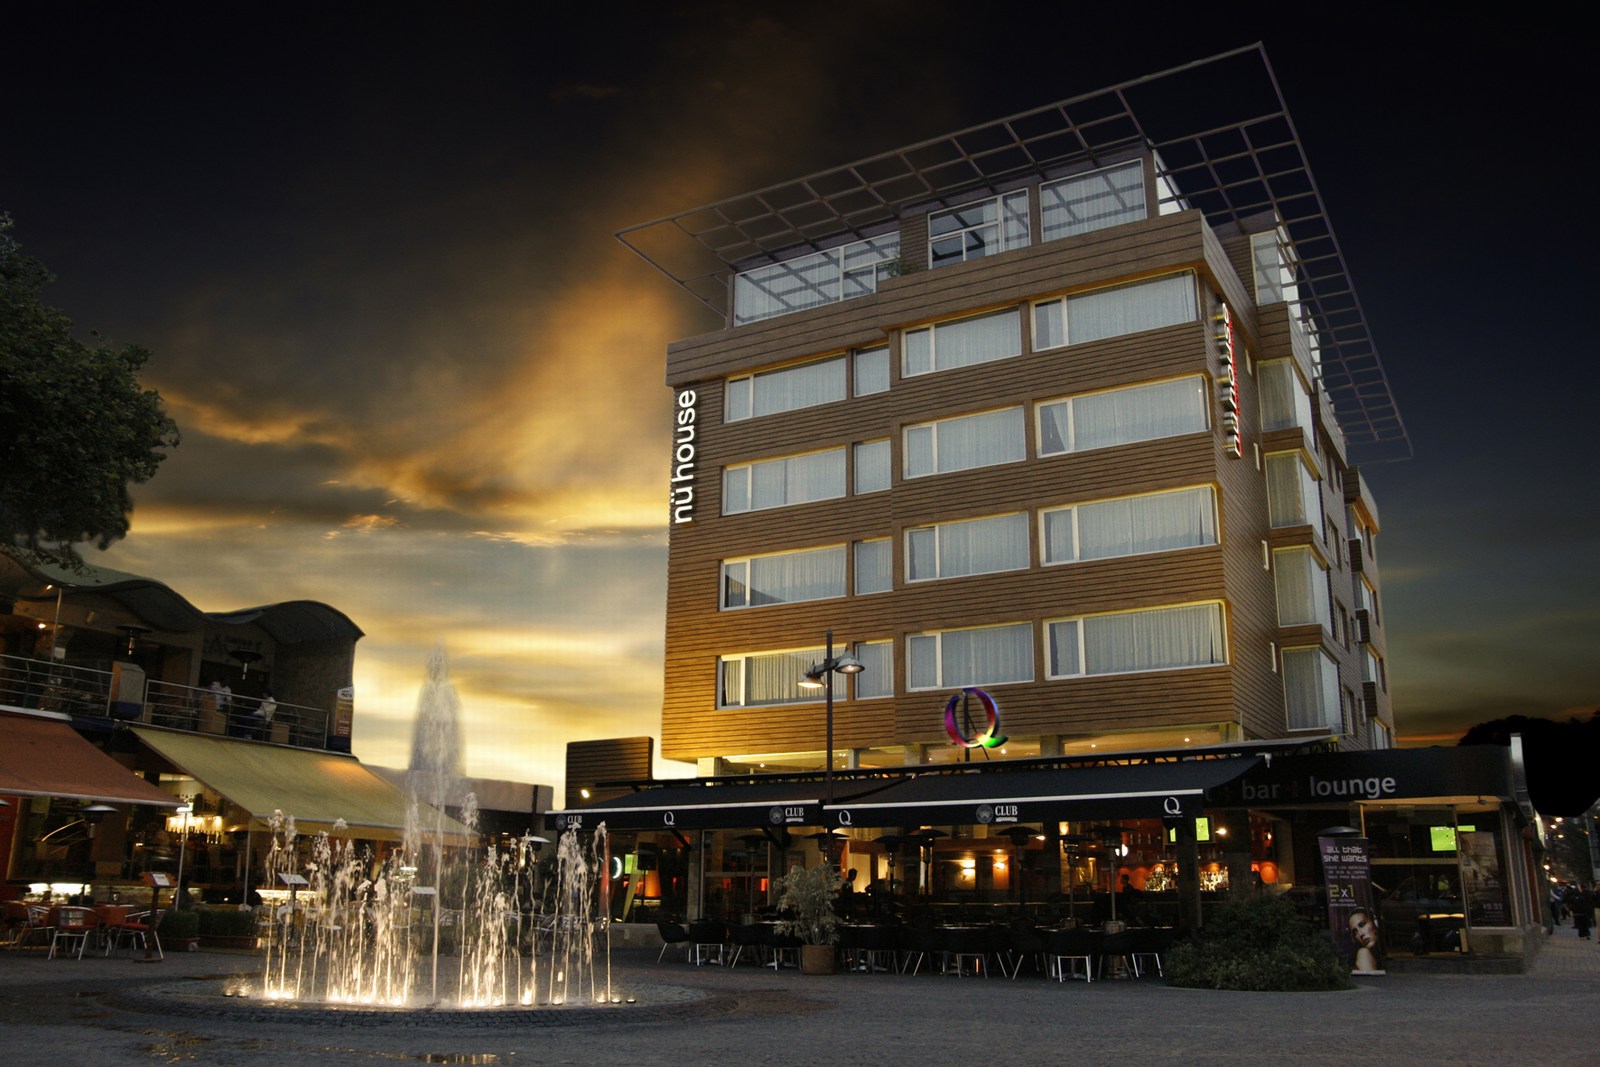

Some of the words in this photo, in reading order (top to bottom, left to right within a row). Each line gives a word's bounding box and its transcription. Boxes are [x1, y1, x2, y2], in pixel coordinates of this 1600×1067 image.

[671, 389, 696, 483] house
[670, 486, 693, 524] nü
[944, 687, 1008, 748] Q
[1241, 779, 1281, 800] bar
[1309, 775, 1396, 799] lounge
[785, 807, 805, 817] CLUB
[994, 805, 1018, 816] CLUB
[1163, 796, 1183, 815] Q
[567, 815, 583, 824] CLUB
[663, 811, 676, 826] Q
[838, 810, 853, 826] Q
